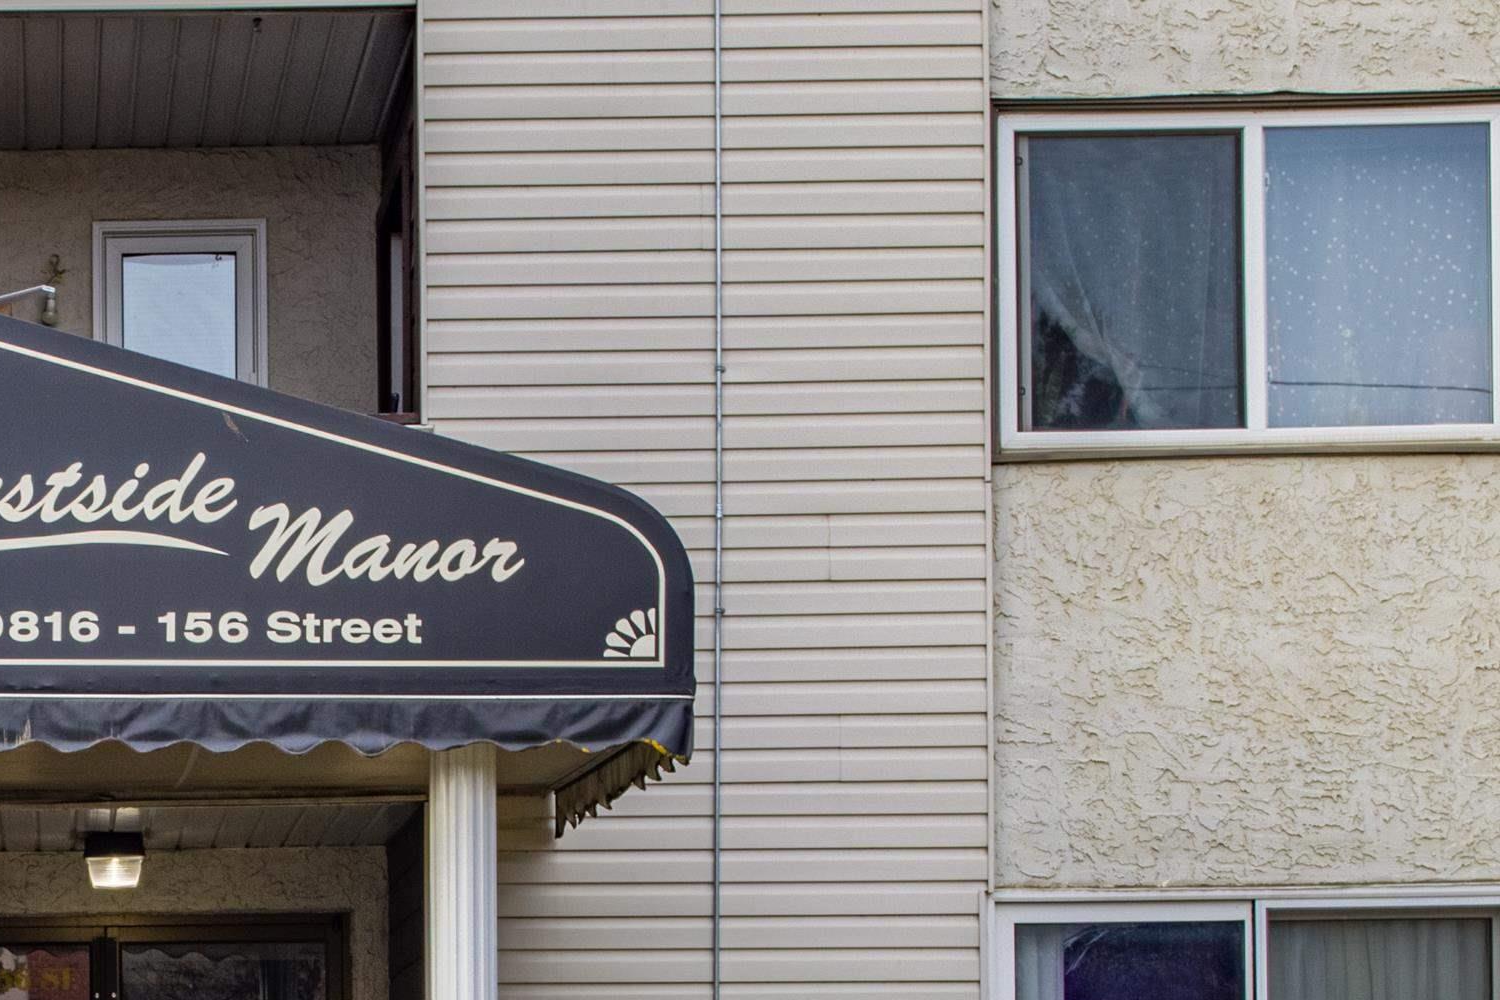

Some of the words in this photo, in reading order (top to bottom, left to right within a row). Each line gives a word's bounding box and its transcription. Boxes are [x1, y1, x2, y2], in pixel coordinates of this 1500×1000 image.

[248, 502, 525, 587] Manor
[157, 610, 249, 644] 156
[266, 610, 423, 644] Street
